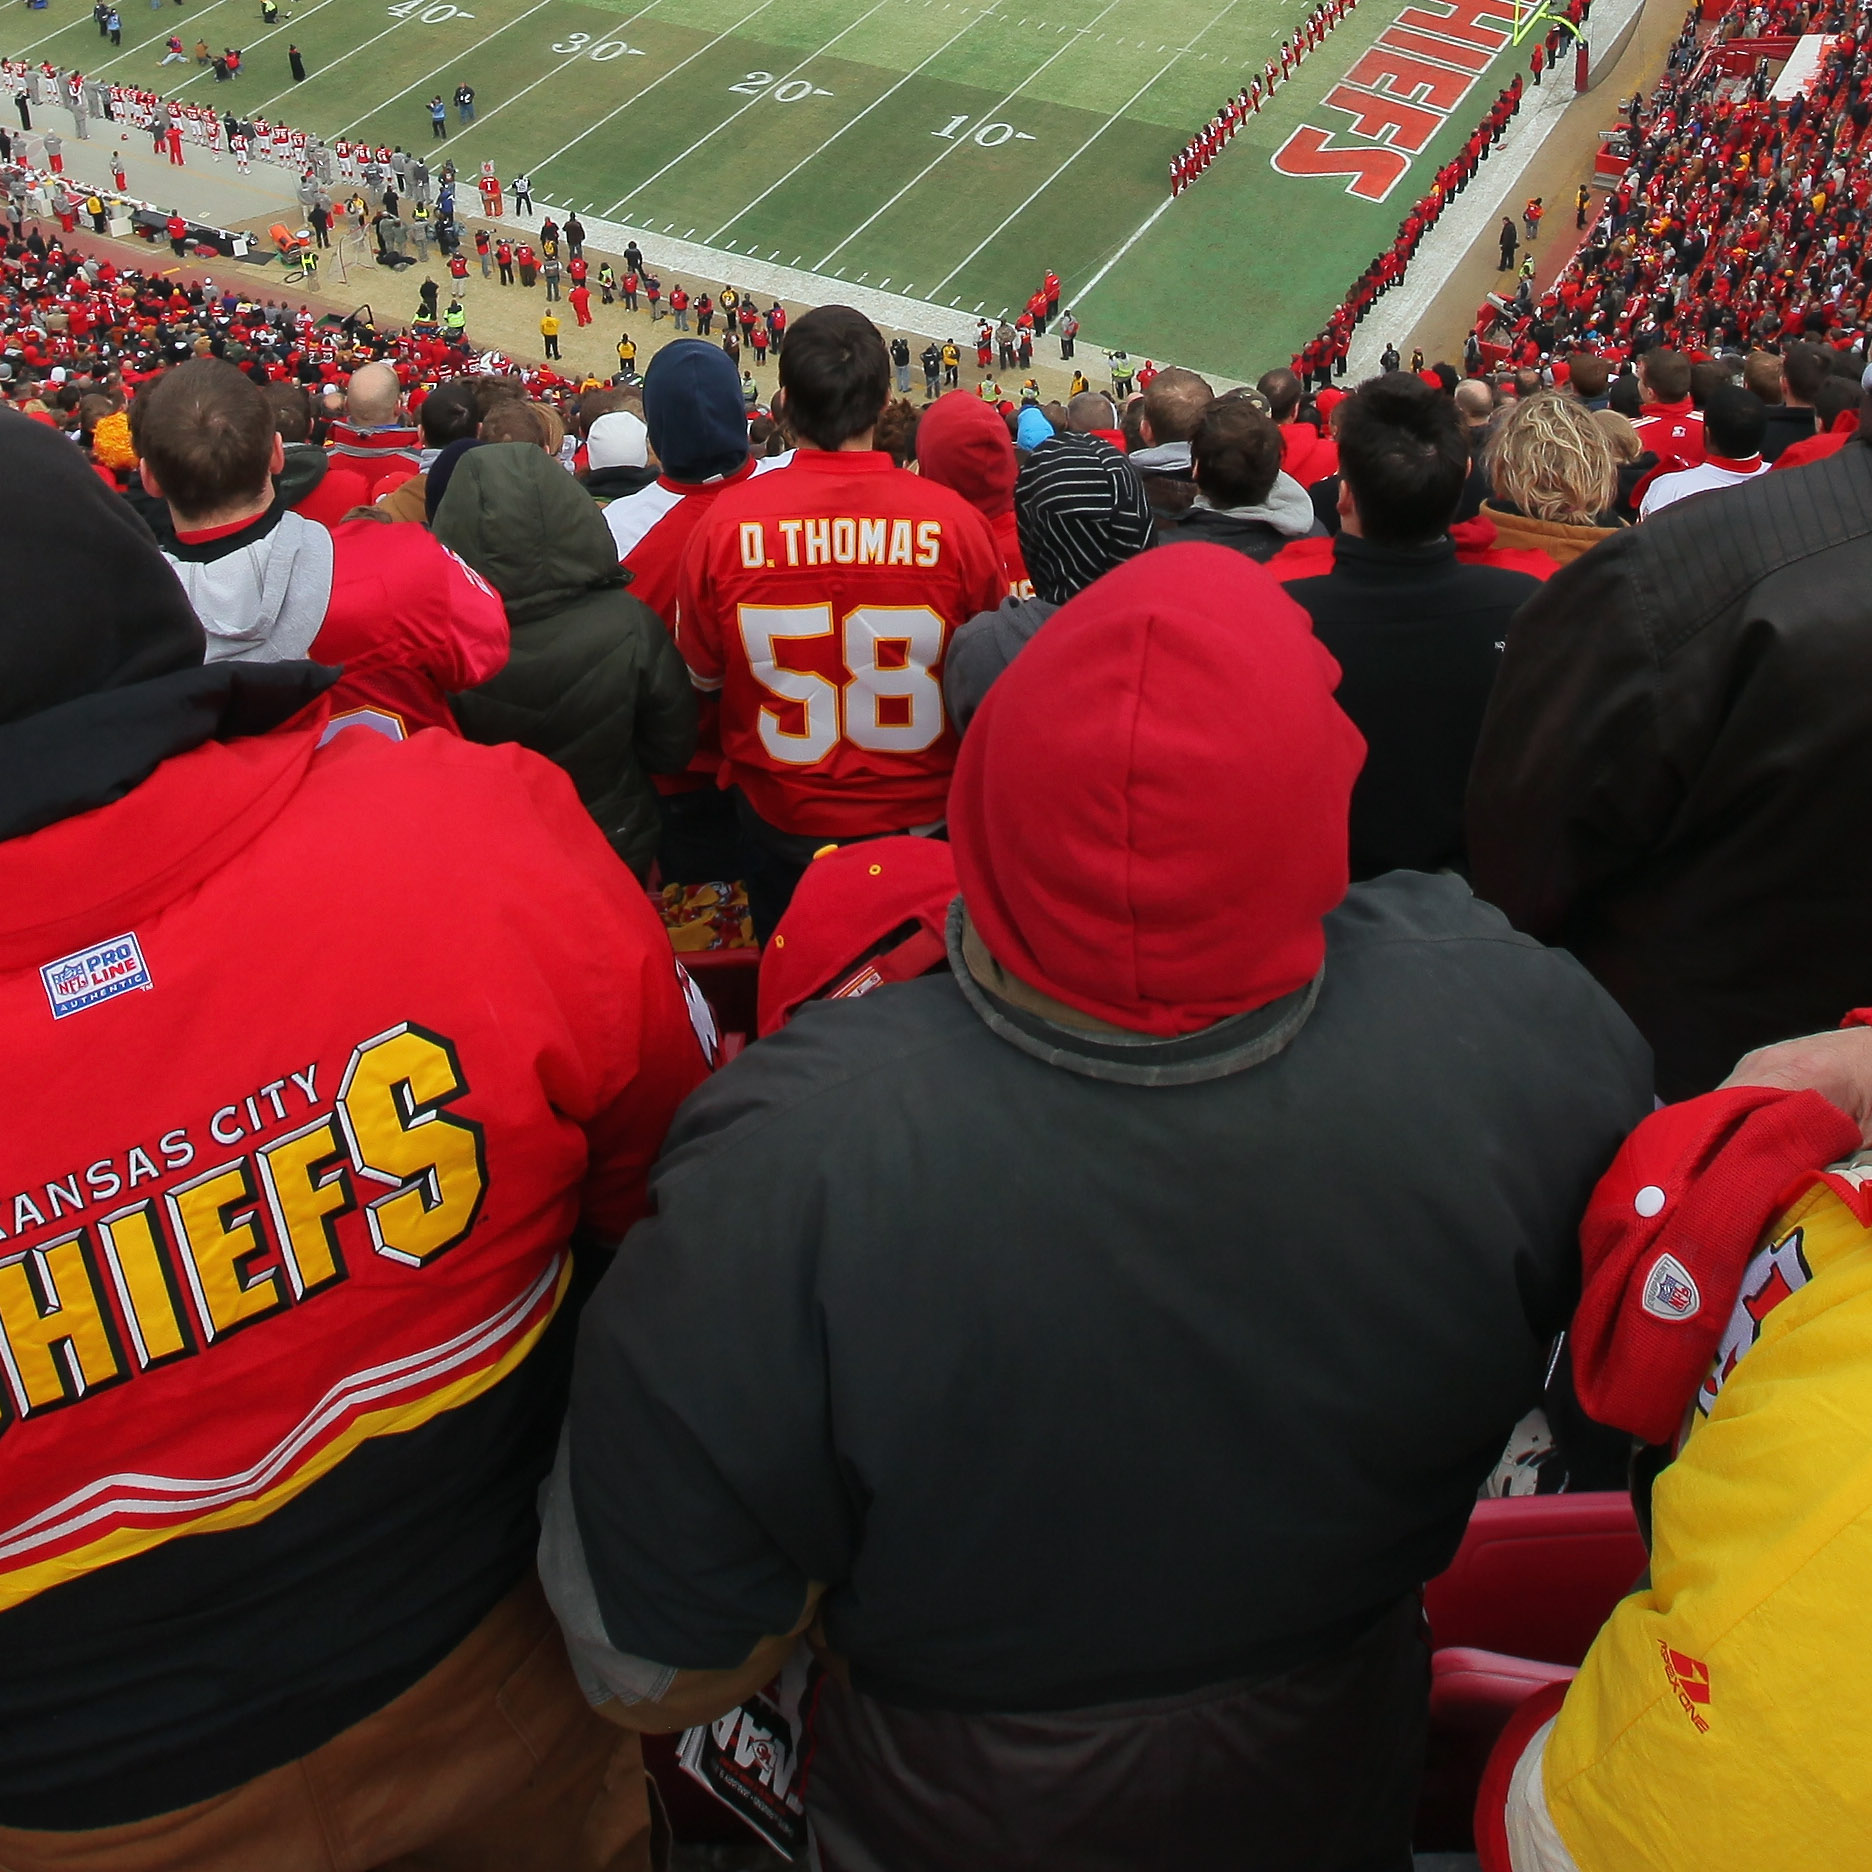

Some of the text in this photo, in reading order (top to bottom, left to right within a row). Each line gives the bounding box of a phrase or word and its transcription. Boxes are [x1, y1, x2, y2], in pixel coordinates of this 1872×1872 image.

[778, 517, 943, 568] THOMAS
[736, 601, 947, 766] 58
[86, 943, 132, 973] PRO
[91, 957, 137, 986] LINE
[57, 976, 88, 995] NFL
[60, 974, 143, 1011] AUTHENTIC
[208, 1061, 326, 1149] CITY
[1679, 1693, 1710, 1734] ONE
